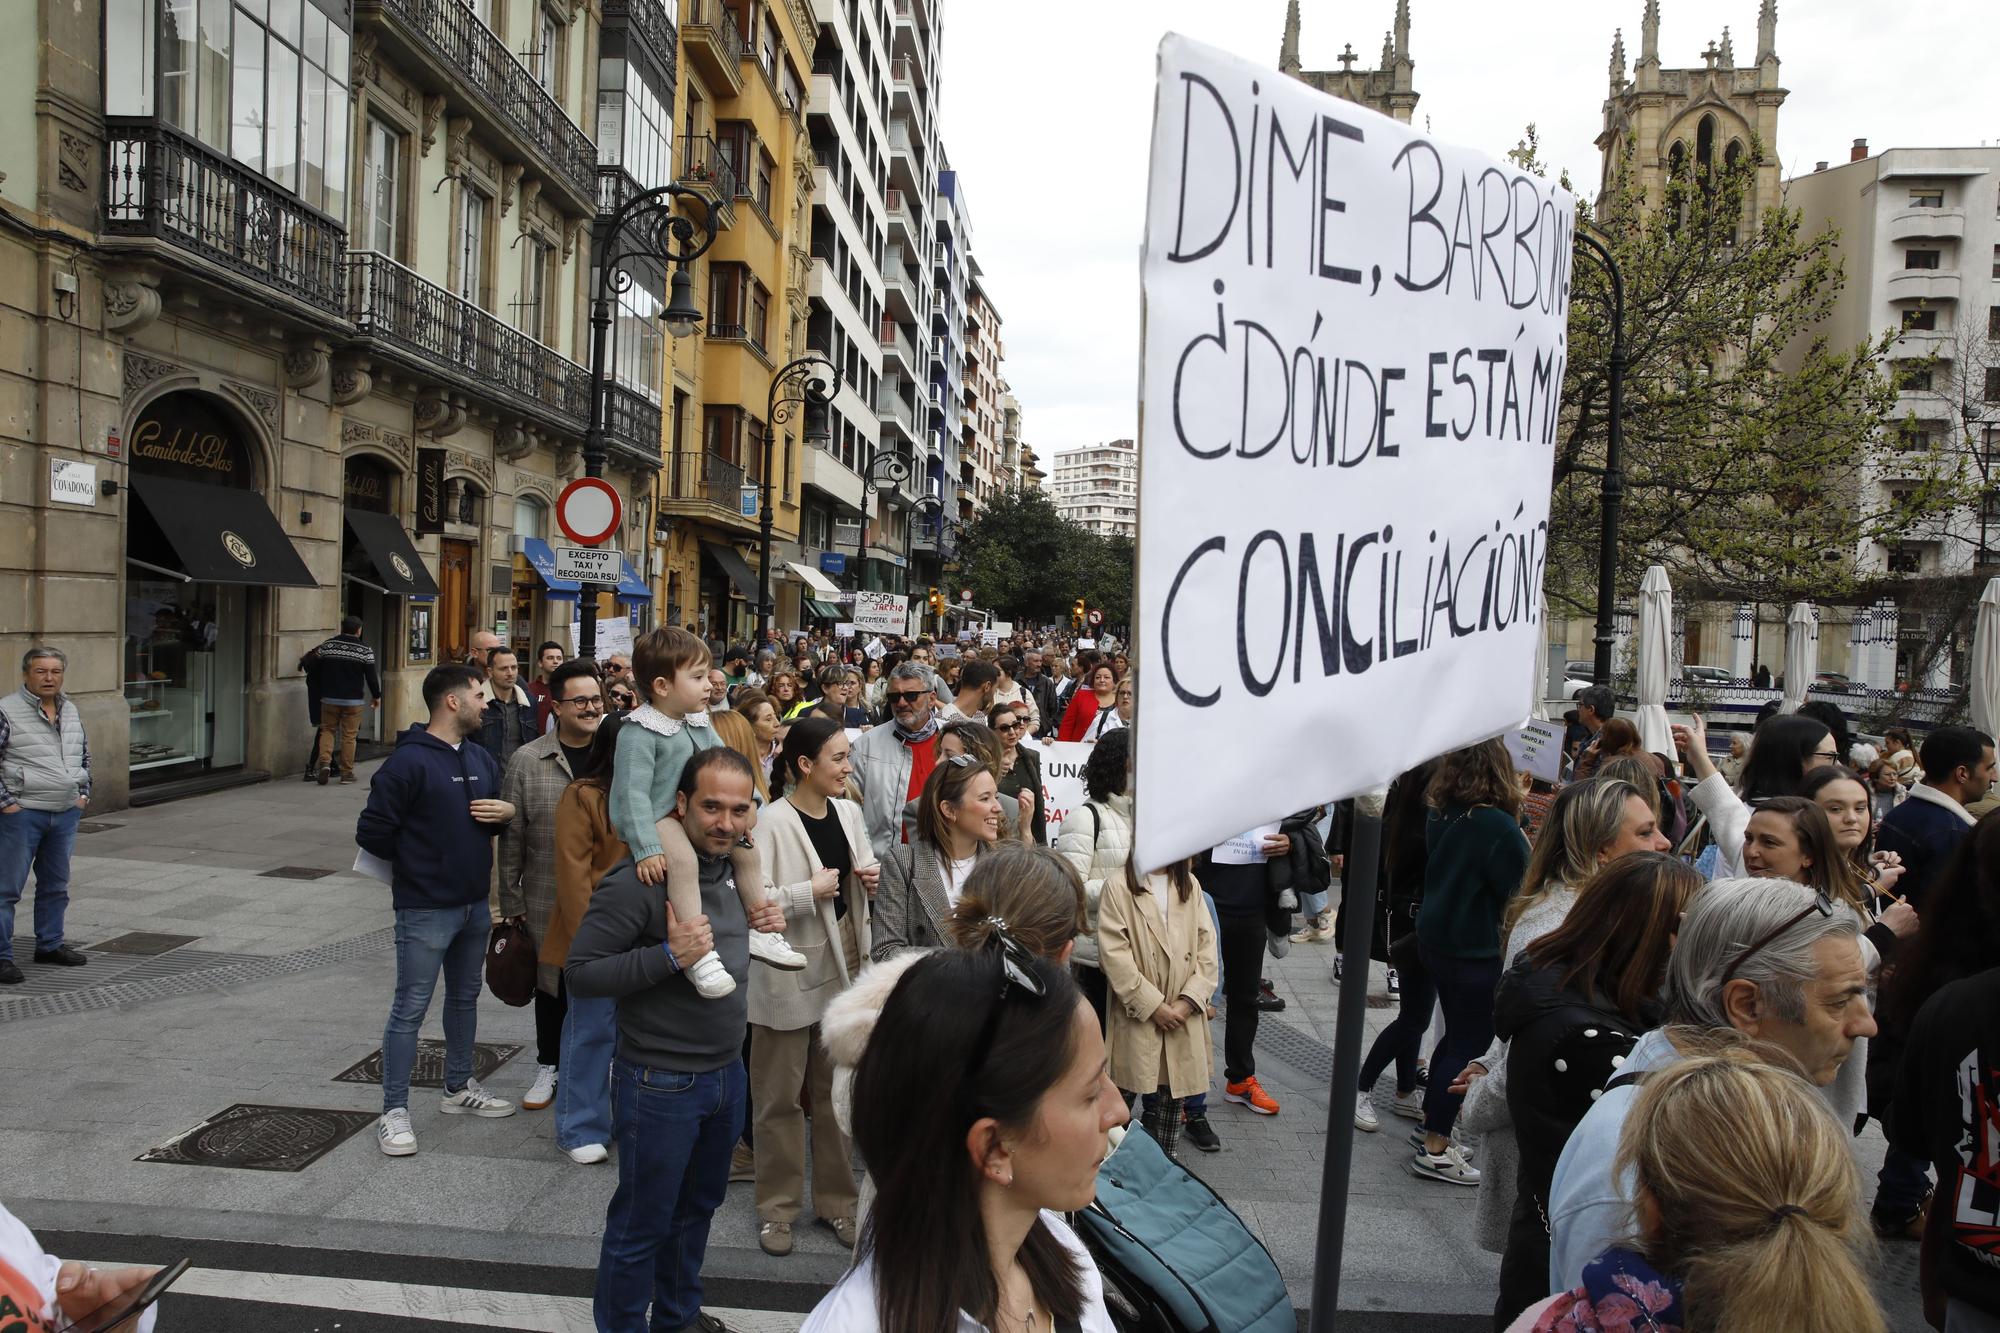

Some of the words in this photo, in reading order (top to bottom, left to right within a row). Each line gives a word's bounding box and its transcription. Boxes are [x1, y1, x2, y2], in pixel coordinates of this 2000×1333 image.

[1426, 322, 1521, 443] ESTÁ
[132, 420, 181, 462] Camilo
[195, 434, 233, 472] Blas
[54, 479, 94, 496] COVADONGA
[568, 550, 609, 561] EXCEPTO
[573, 561, 593, 569] TAXI
[557, 569, 599, 580] RECOGIDA
[600, 571, 618, 581] RSU
[860, 592, 894, 605] SESPA
[872, 603, 904, 612] JARRIO
[1527, 725, 1552, 738] ERMERÍA
[1520, 733, 1538, 743] GRUPO
